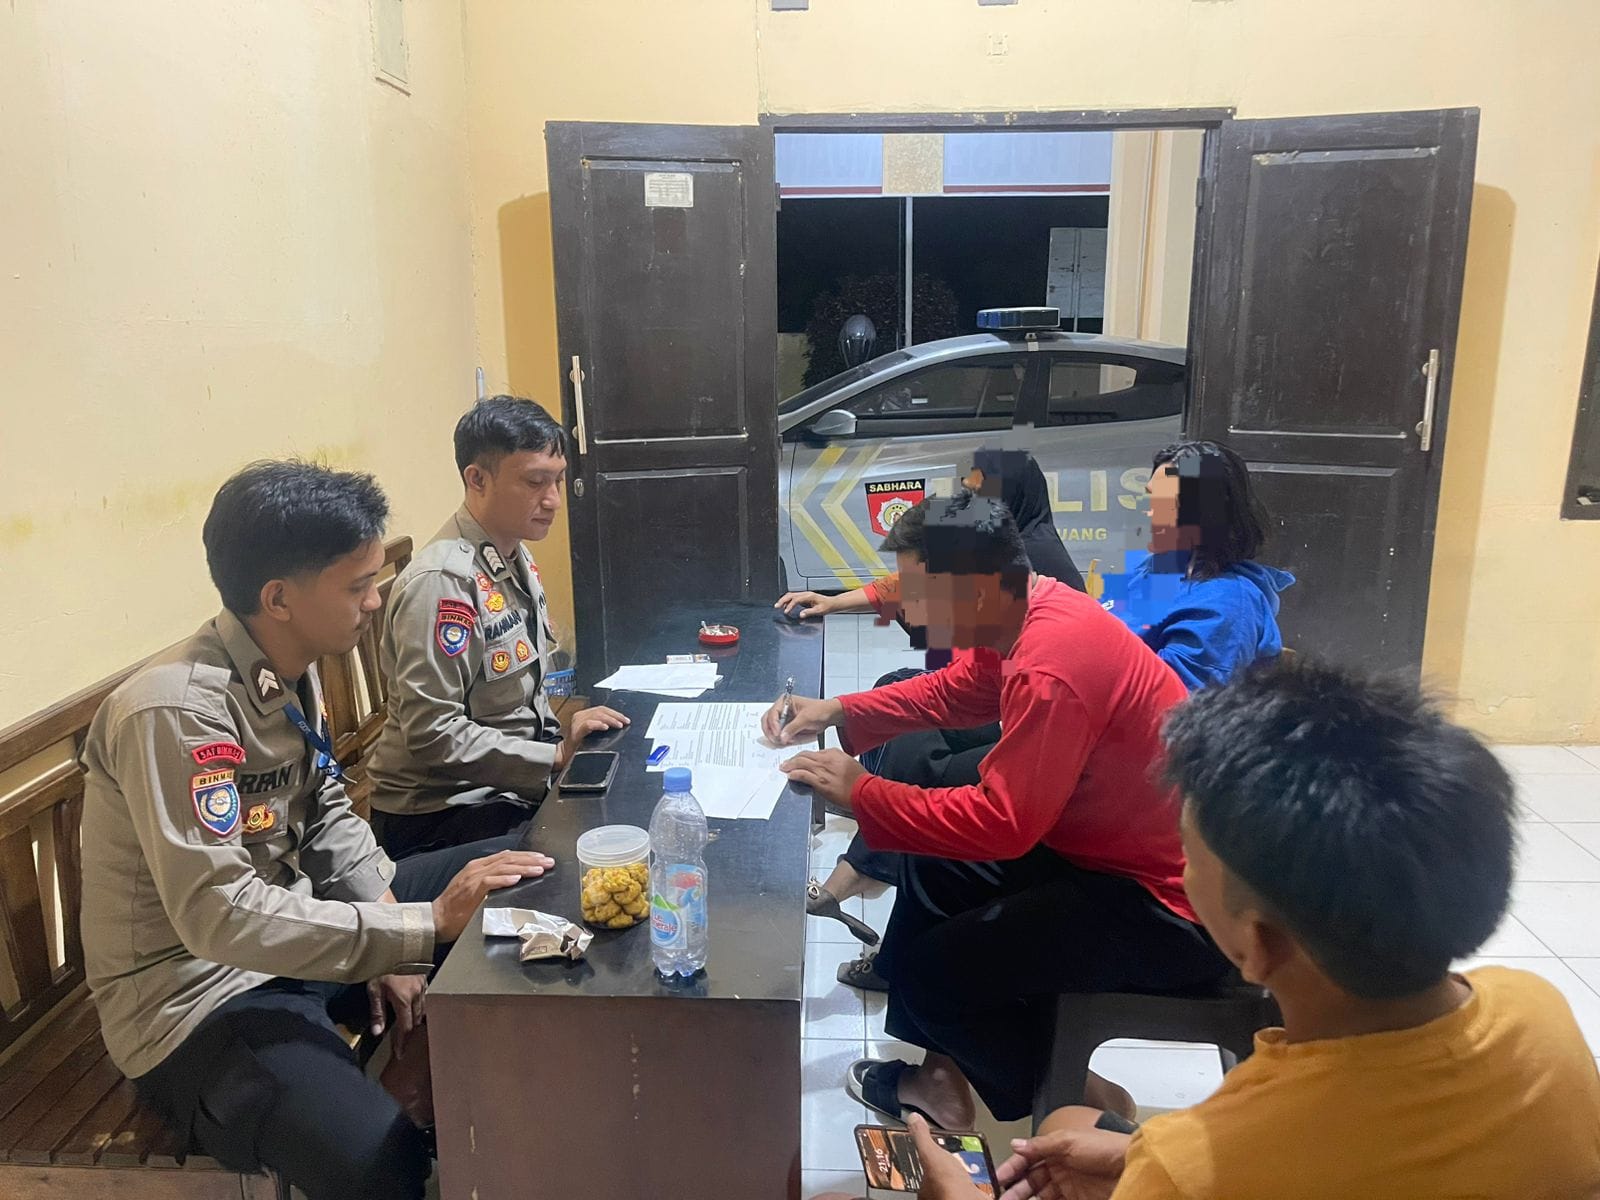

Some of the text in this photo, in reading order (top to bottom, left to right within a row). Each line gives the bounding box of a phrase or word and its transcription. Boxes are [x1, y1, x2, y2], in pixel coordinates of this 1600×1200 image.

[869, 481, 922, 493] SABHARA
[1045, 467, 1151, 512] LIS
[484, 609, 522, 641] RAHMAN
